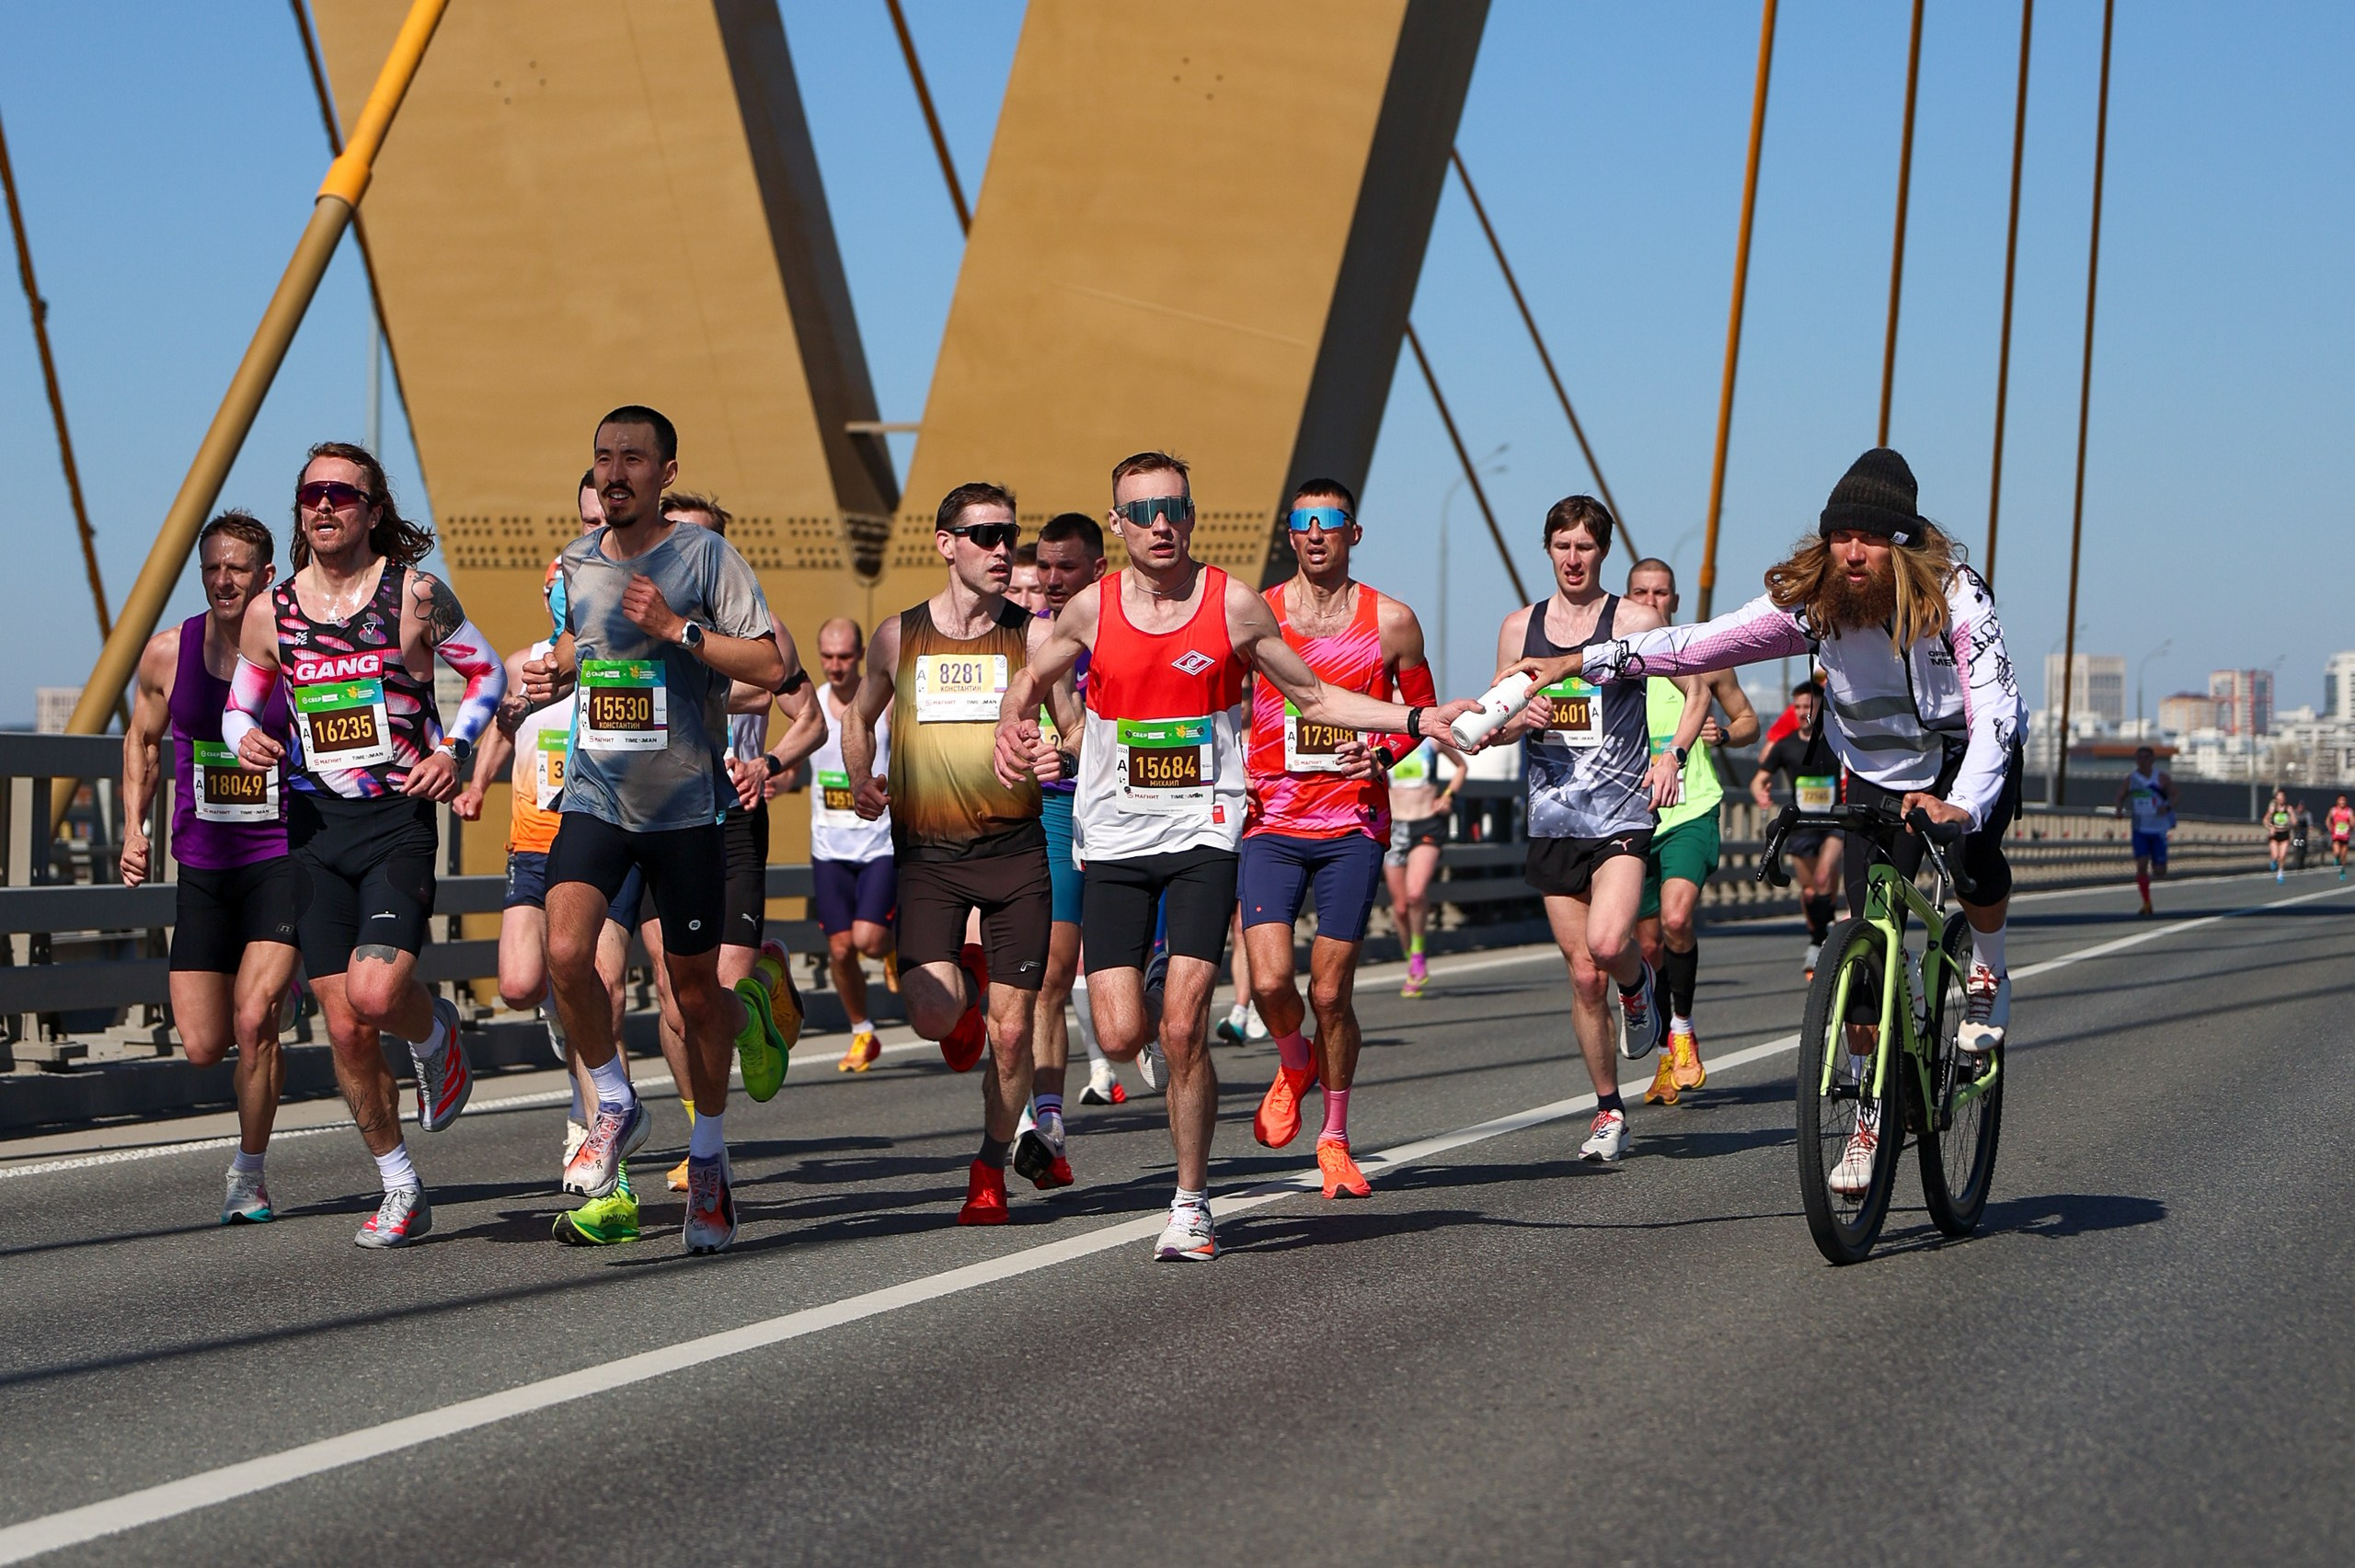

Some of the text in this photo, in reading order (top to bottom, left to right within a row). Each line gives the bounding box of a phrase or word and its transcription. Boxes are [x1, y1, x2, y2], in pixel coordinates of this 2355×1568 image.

[295, 655, 380, 681] GANG
[940, 663, 982, 683] 8281
[593, 696, 649, 721] 15530
[316, 715, 373, 744] 16235
[599, 721, 640, 729] КОНСТАНТИН
[1135, 755, 1196, 779] 15684
[210, 774, 263, 796] 18049
